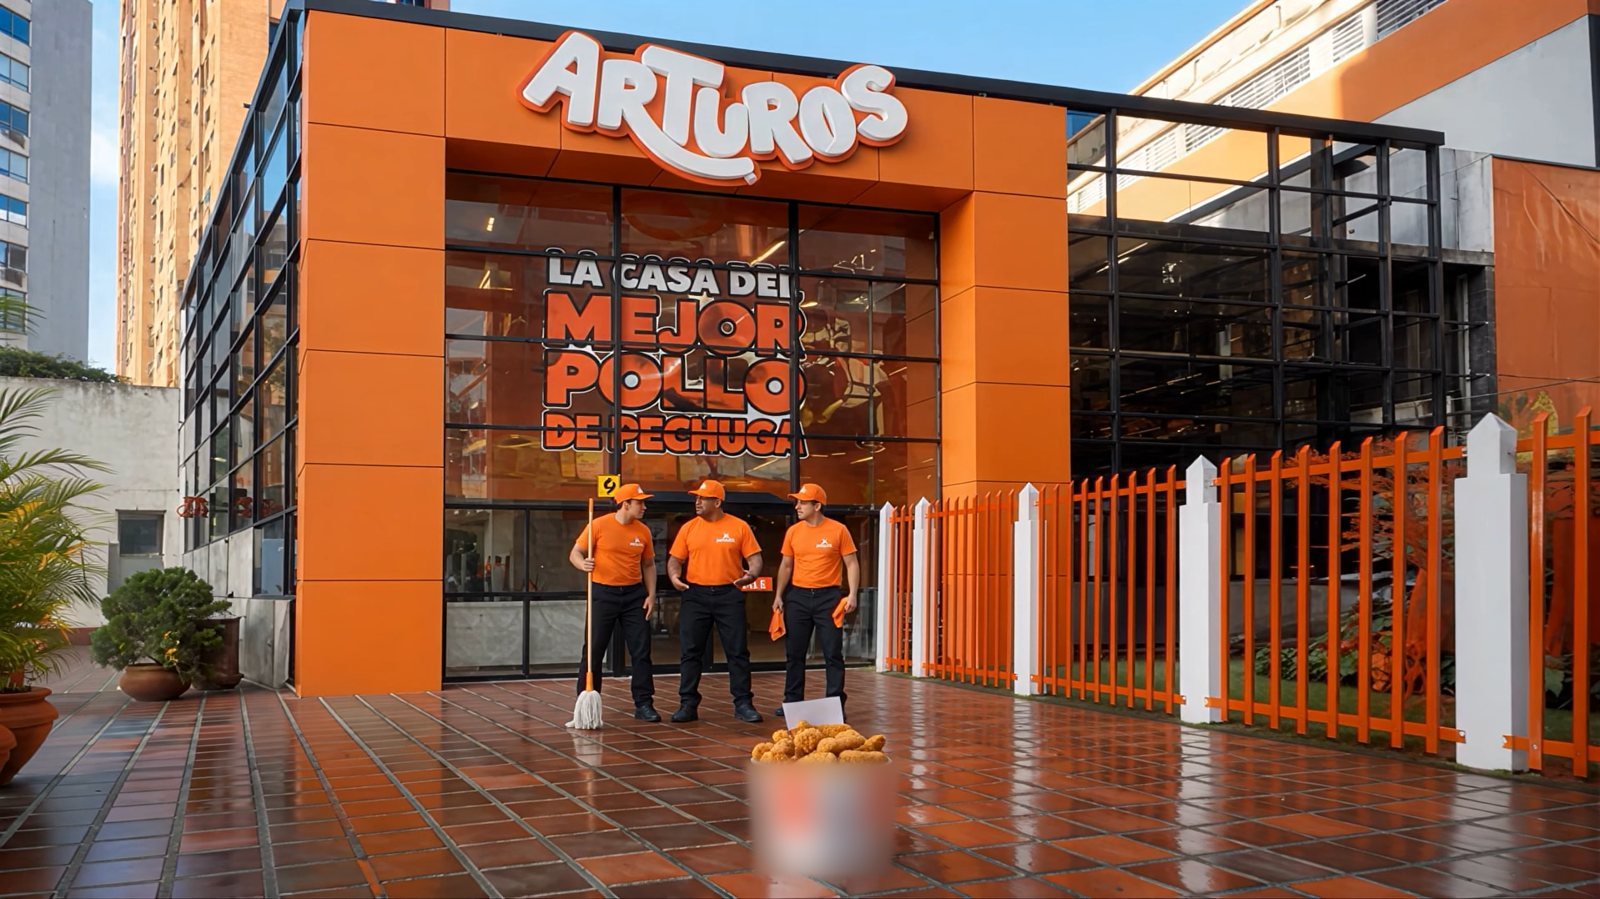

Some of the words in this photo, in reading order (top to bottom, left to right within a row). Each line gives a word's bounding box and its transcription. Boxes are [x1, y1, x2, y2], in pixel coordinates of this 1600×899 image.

[520, 30, 909, 185] ARTUROS
[546, 250, 605, 289] LA
[613, 256, 721, 296] CASA
[544, 291, 805, 357] MEJOR
[543, 350, 807, 415] POLLO
[543, 411, 602, 451] DE
[608, 414, 806, 458] PECHUGA
